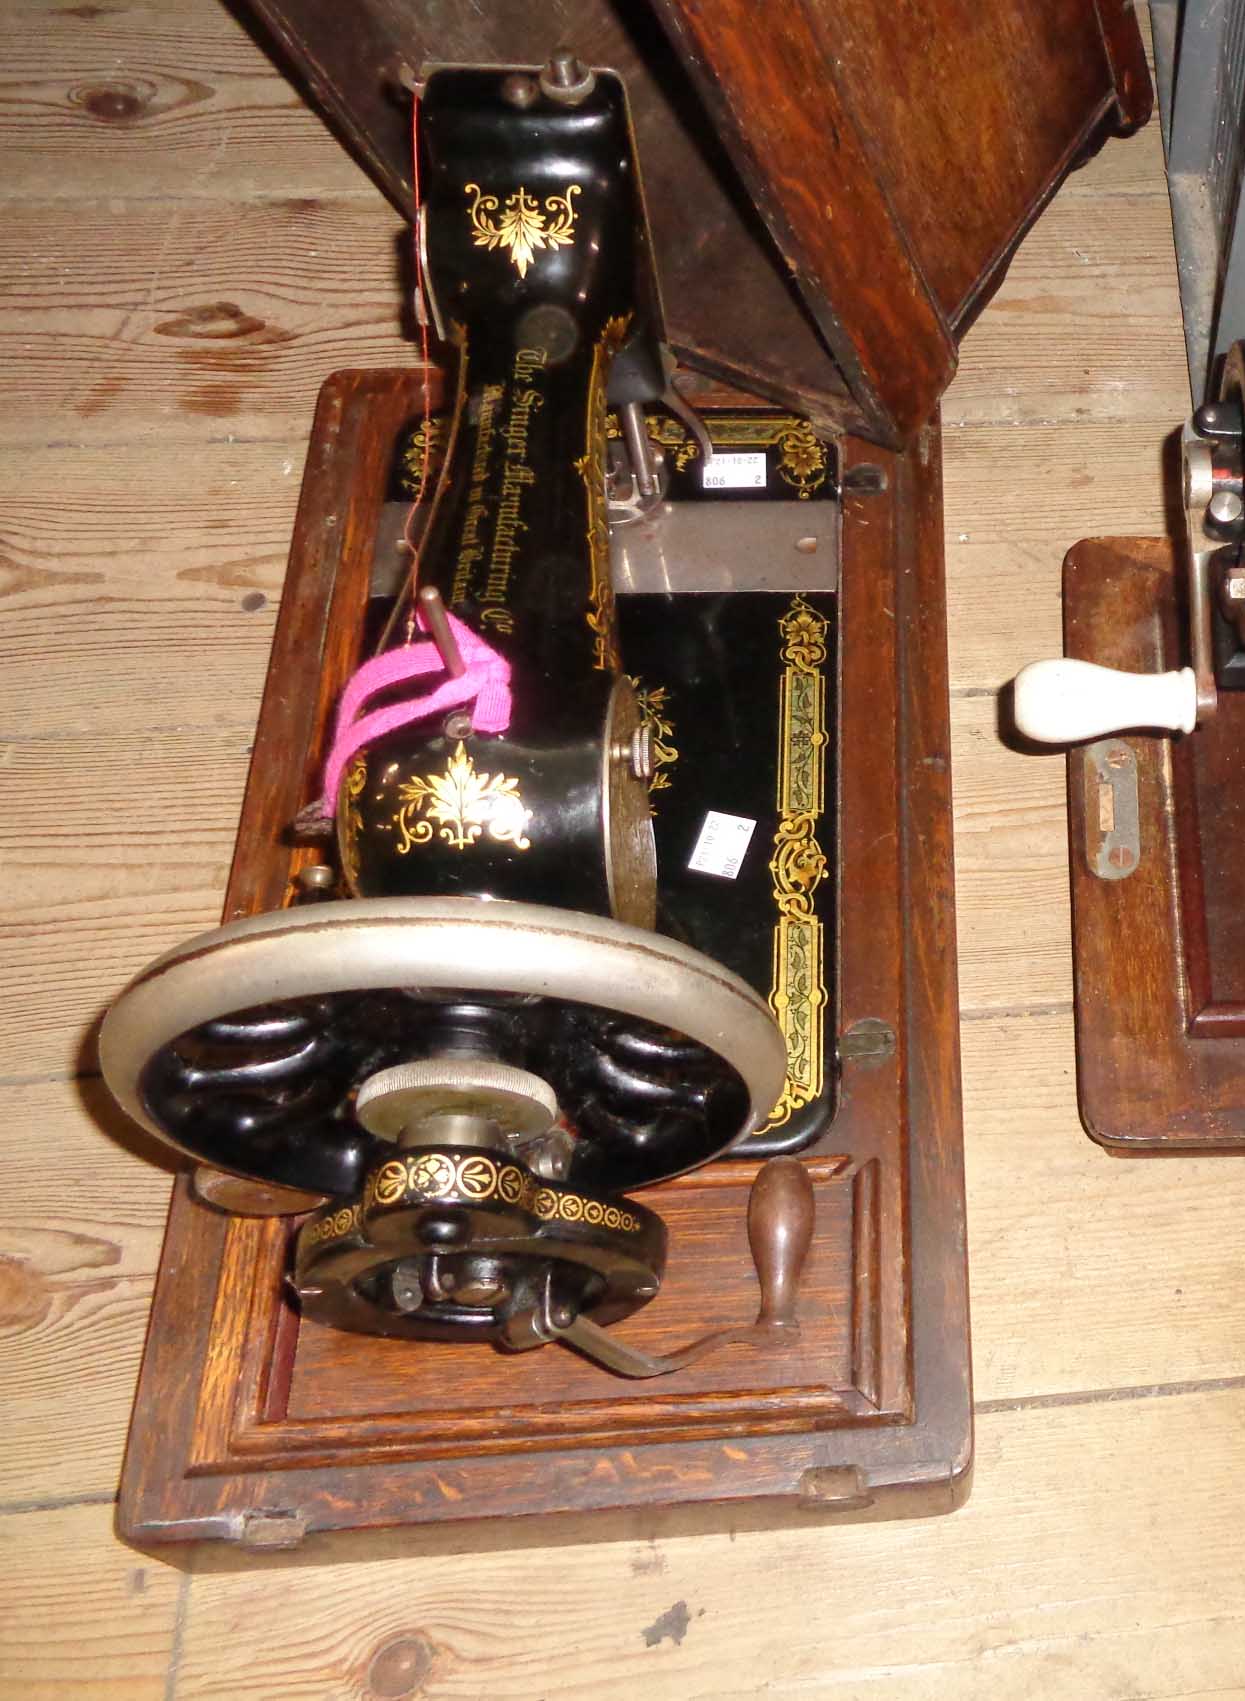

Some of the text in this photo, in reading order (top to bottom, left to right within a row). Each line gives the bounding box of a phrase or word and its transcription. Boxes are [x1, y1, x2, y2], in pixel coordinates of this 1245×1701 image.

[515, 349, 547, 382] The
[502, 389, 544, 457] Singer
[452, 384, 504, 603] Manufactured in Great Britain
[705, 474, 762, 487] 806 2
[479, 463, 536, 602] Manufacturing
[721, 823, 750, 877] 806 2
